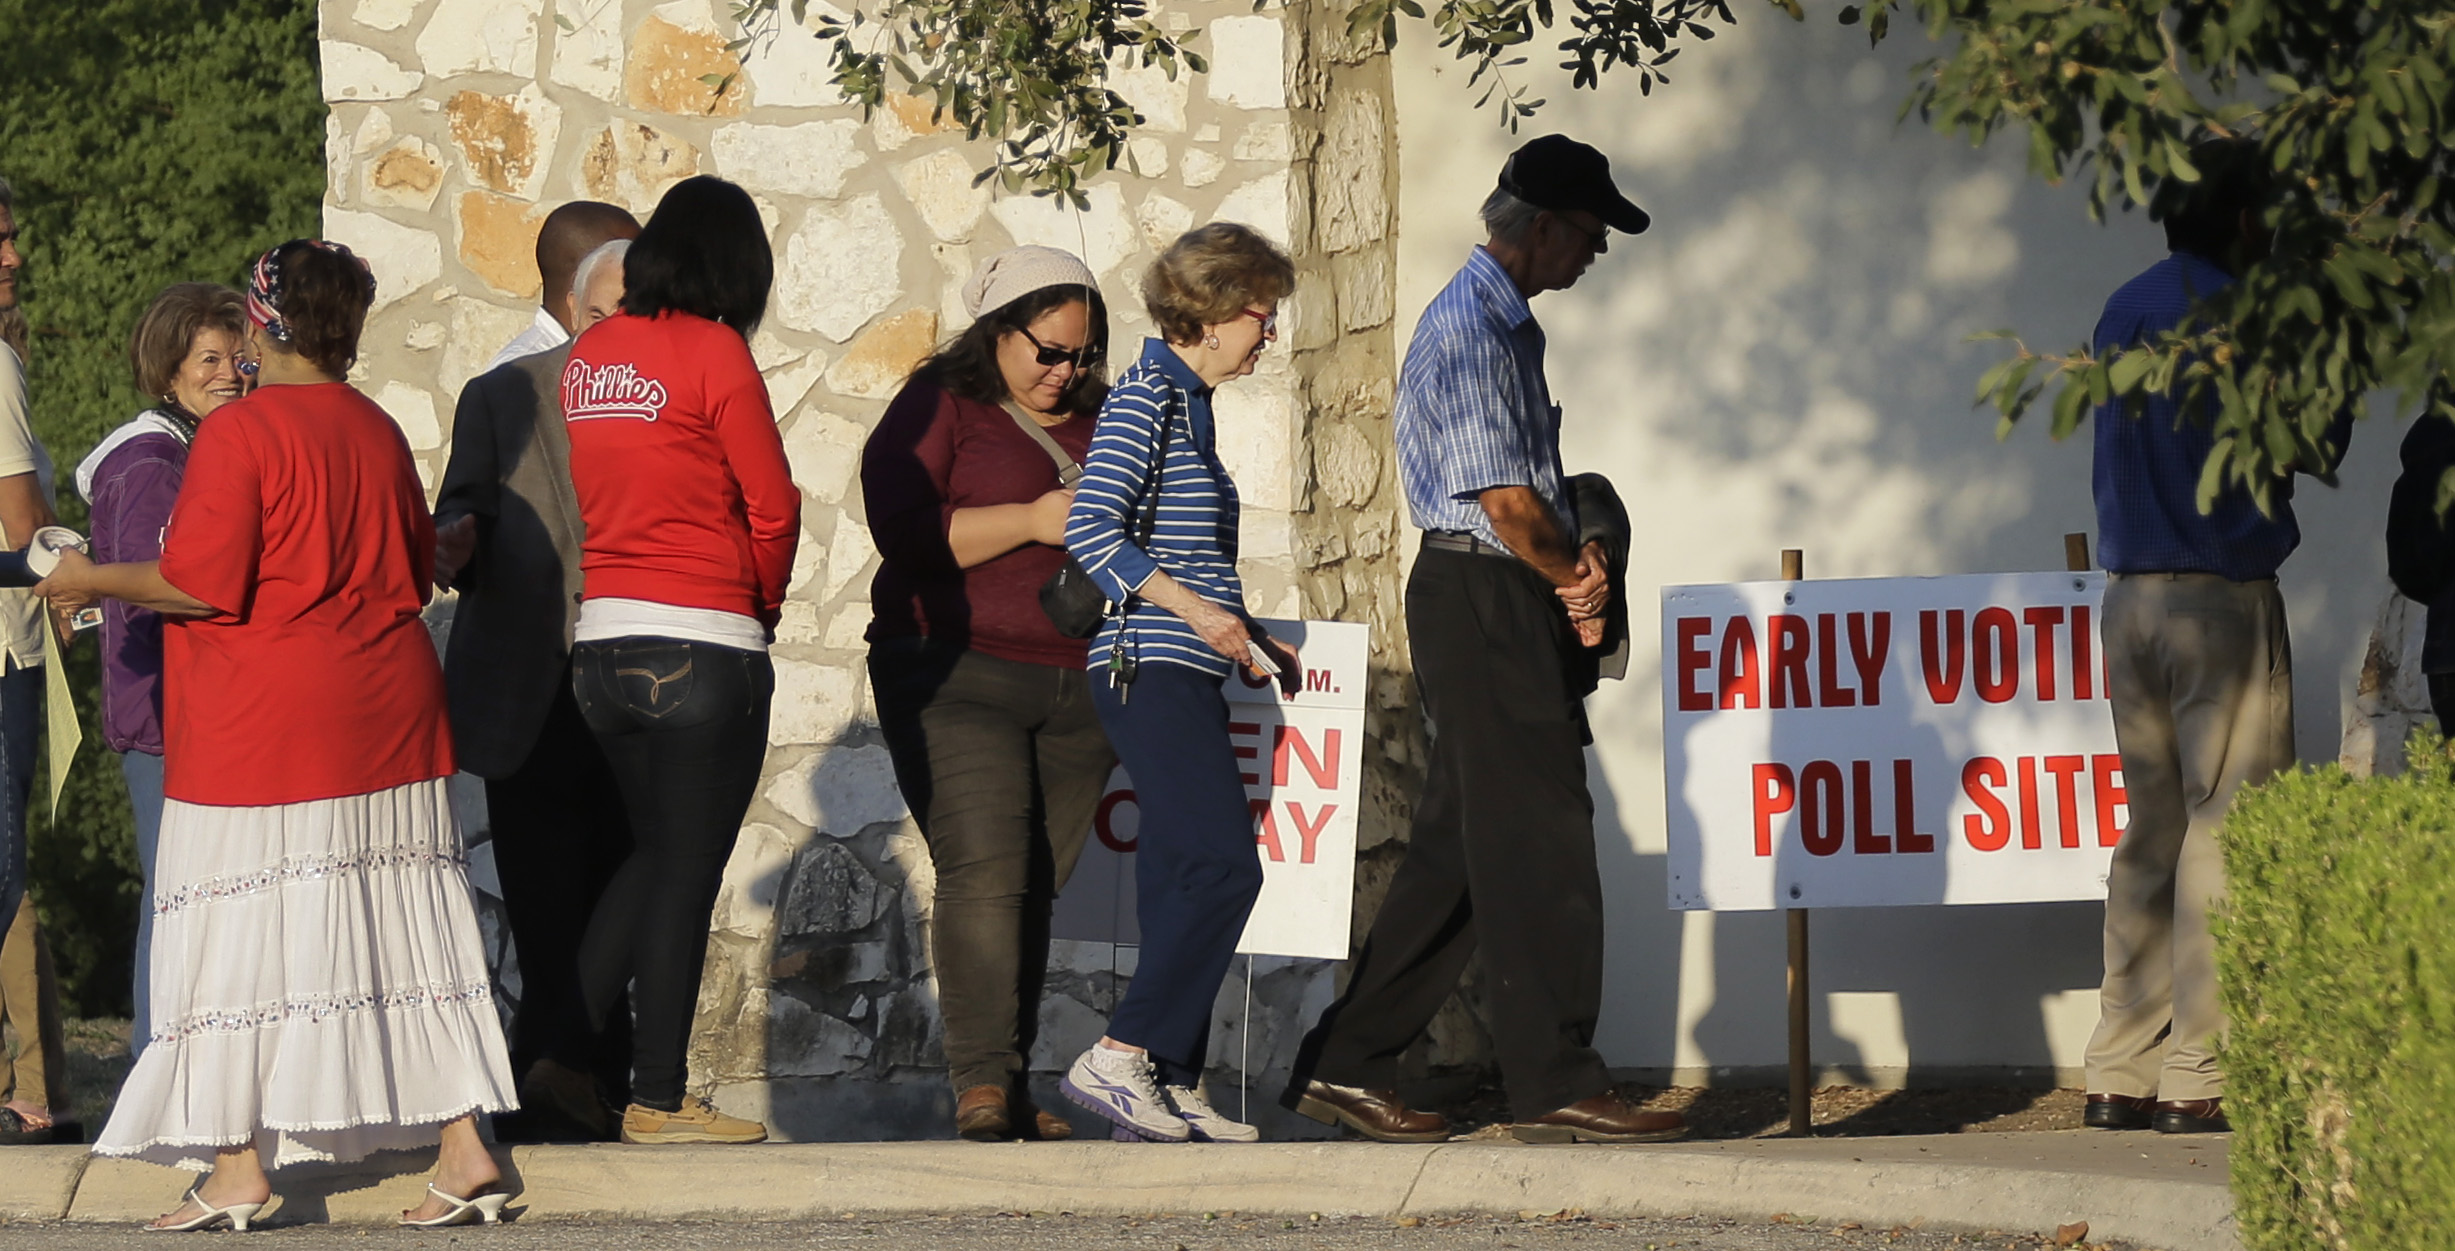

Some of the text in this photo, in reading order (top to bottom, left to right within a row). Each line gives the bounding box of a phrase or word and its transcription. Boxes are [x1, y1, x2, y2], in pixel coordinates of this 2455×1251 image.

[563, 358, 668, 411] Phillies
[1677, 605, 2110, 712] EARLY VOTI
[1752, 754, 2129, 857] POLL SITE
